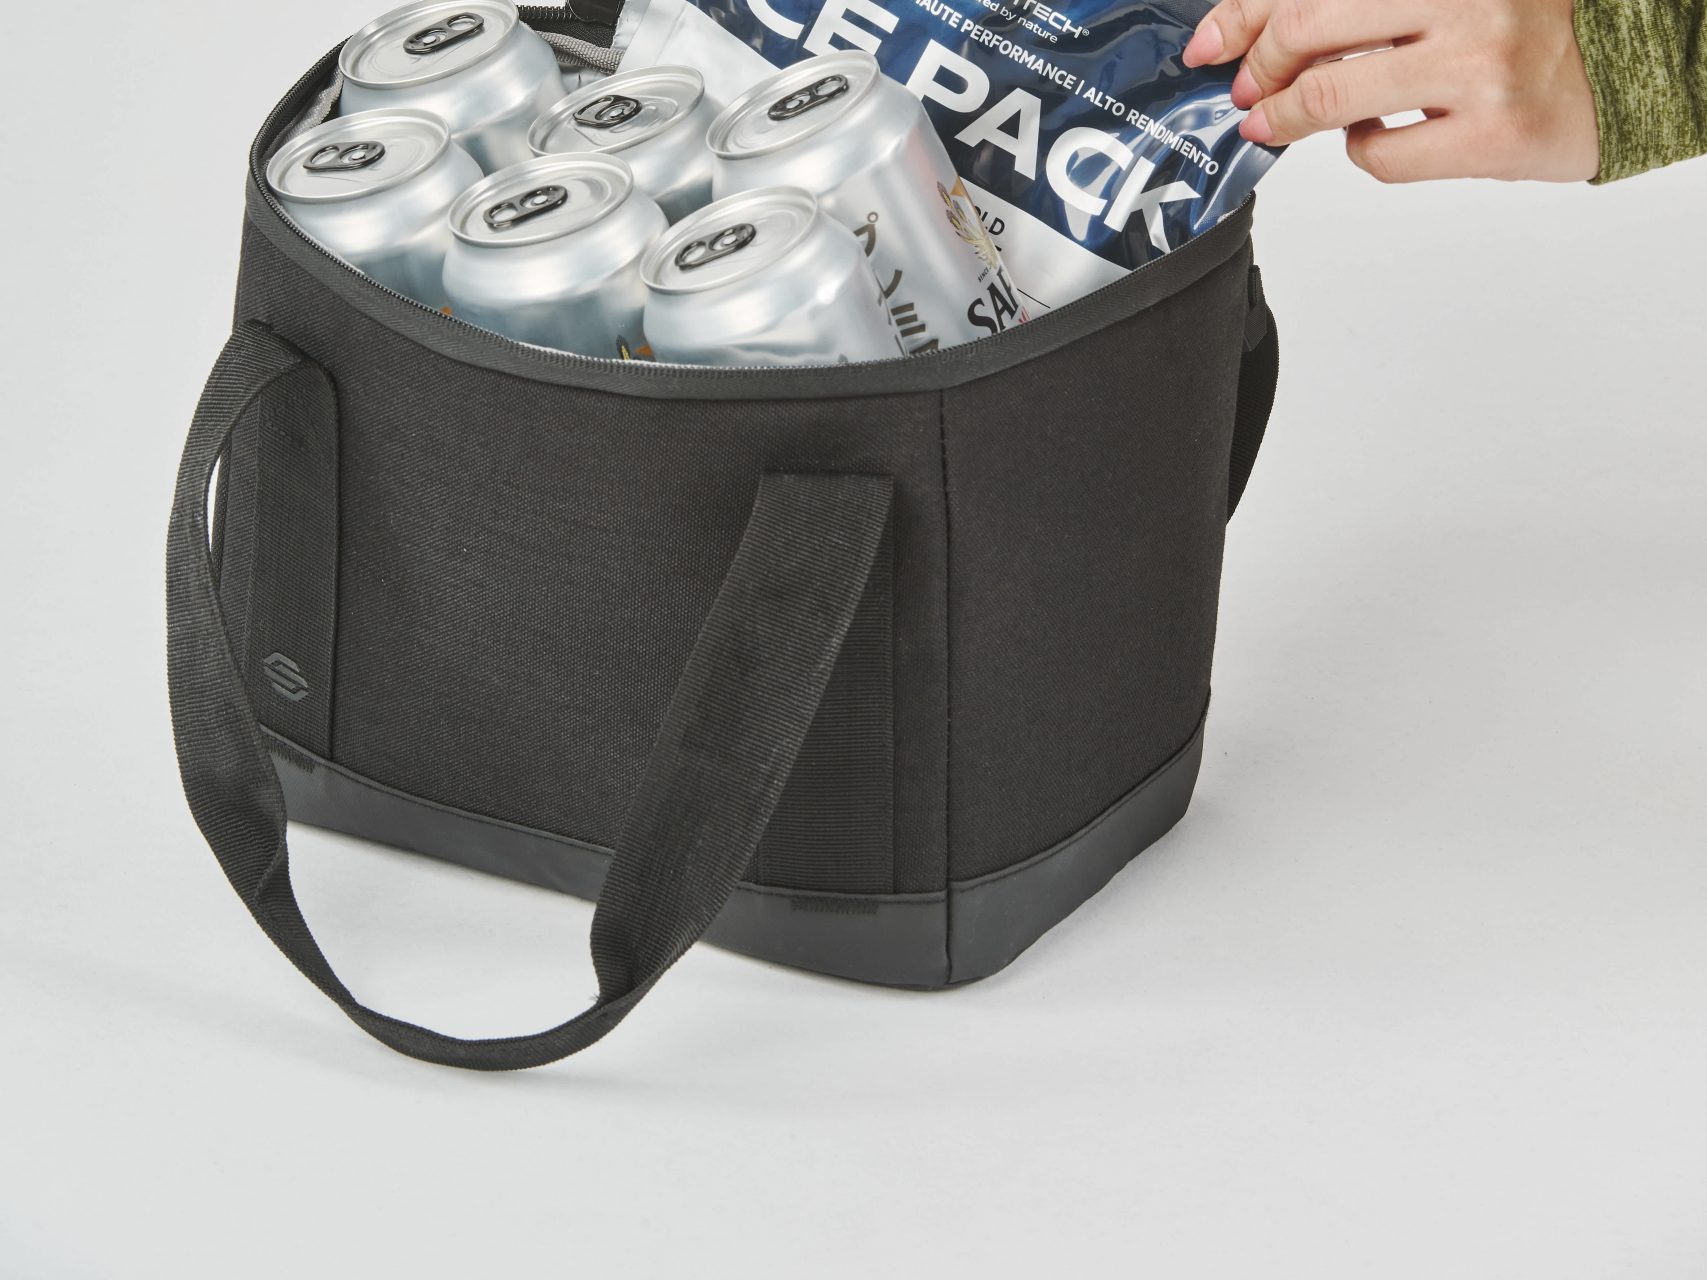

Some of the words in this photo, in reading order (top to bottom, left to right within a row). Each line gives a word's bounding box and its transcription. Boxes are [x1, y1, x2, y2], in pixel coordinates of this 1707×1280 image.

[960, 18, 1077, 90] PERFORMANCE
[1082, 86, 1126, 117] ALTO
[1125, 108, 1220, 176] RENDIMIENTO
[1000, 6, 1017, 21] by
[1017, 16, 1058, 44] nature
[906, 38, 1202, 255] PACK
